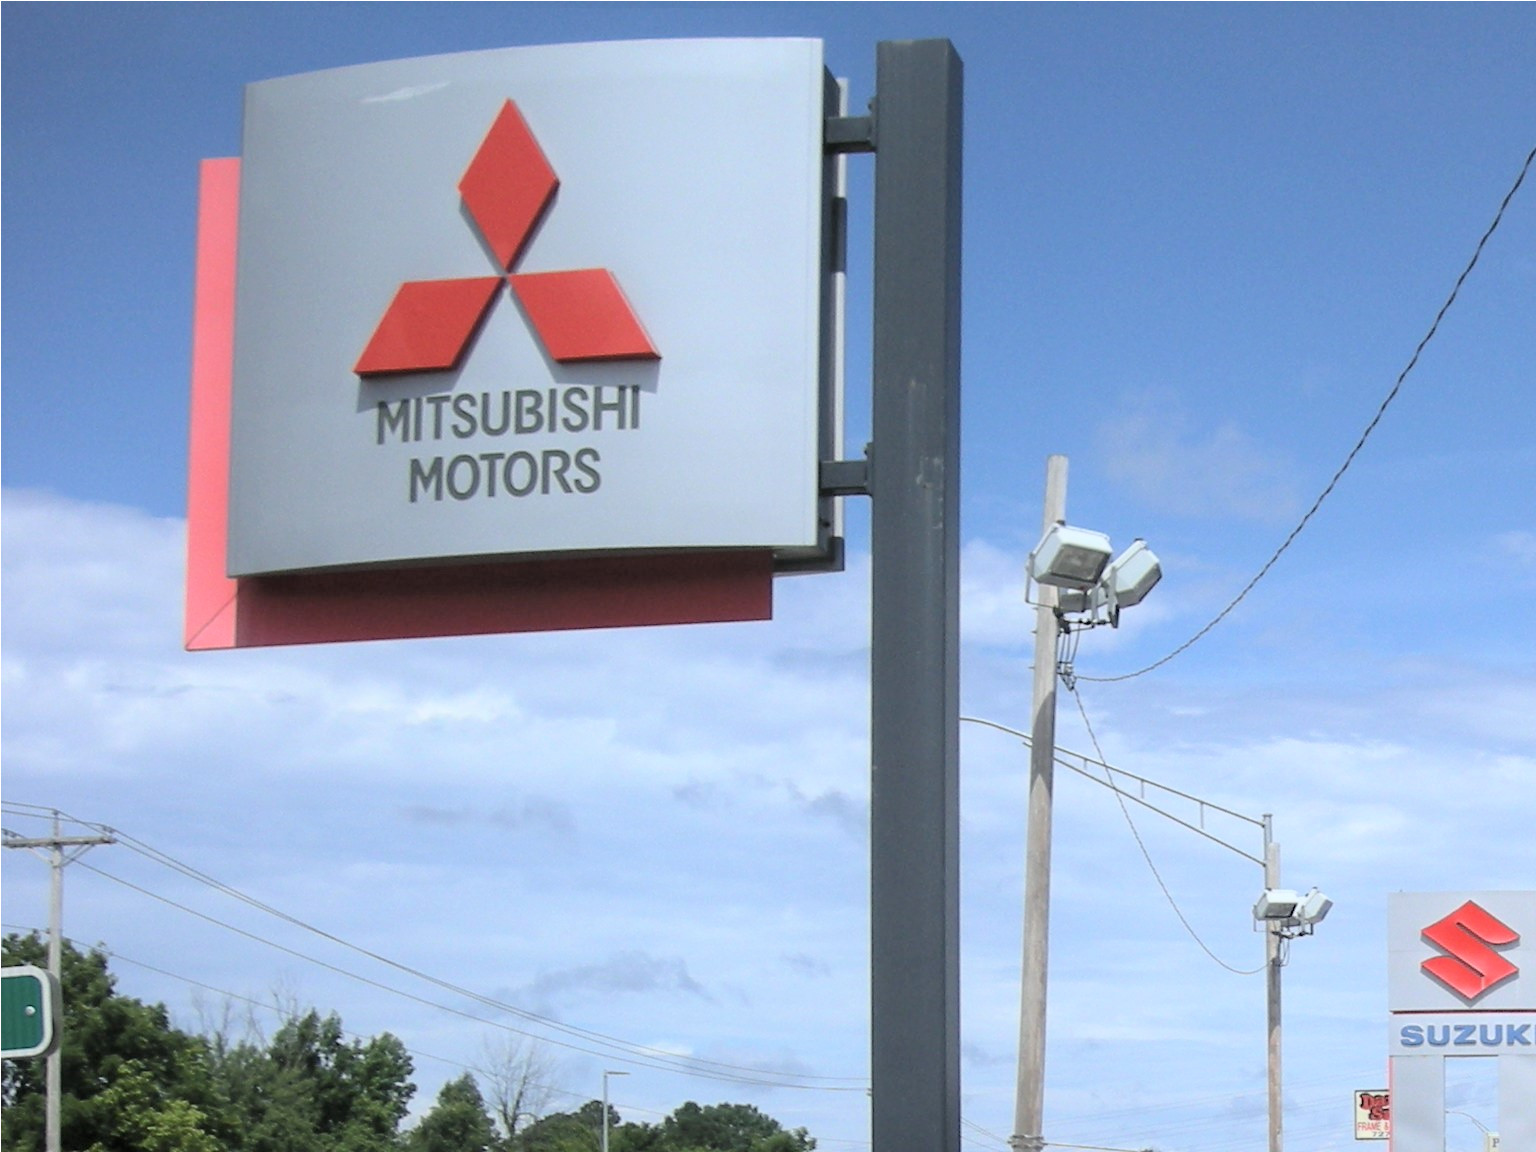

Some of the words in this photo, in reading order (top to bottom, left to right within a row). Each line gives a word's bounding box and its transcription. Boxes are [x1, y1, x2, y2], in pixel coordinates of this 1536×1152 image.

[376, 384, 640, 445] MITSUBISHI
[409, 447, 602, 503] MOTORS
[1357, 1122, 1381, 1131] FRAME
